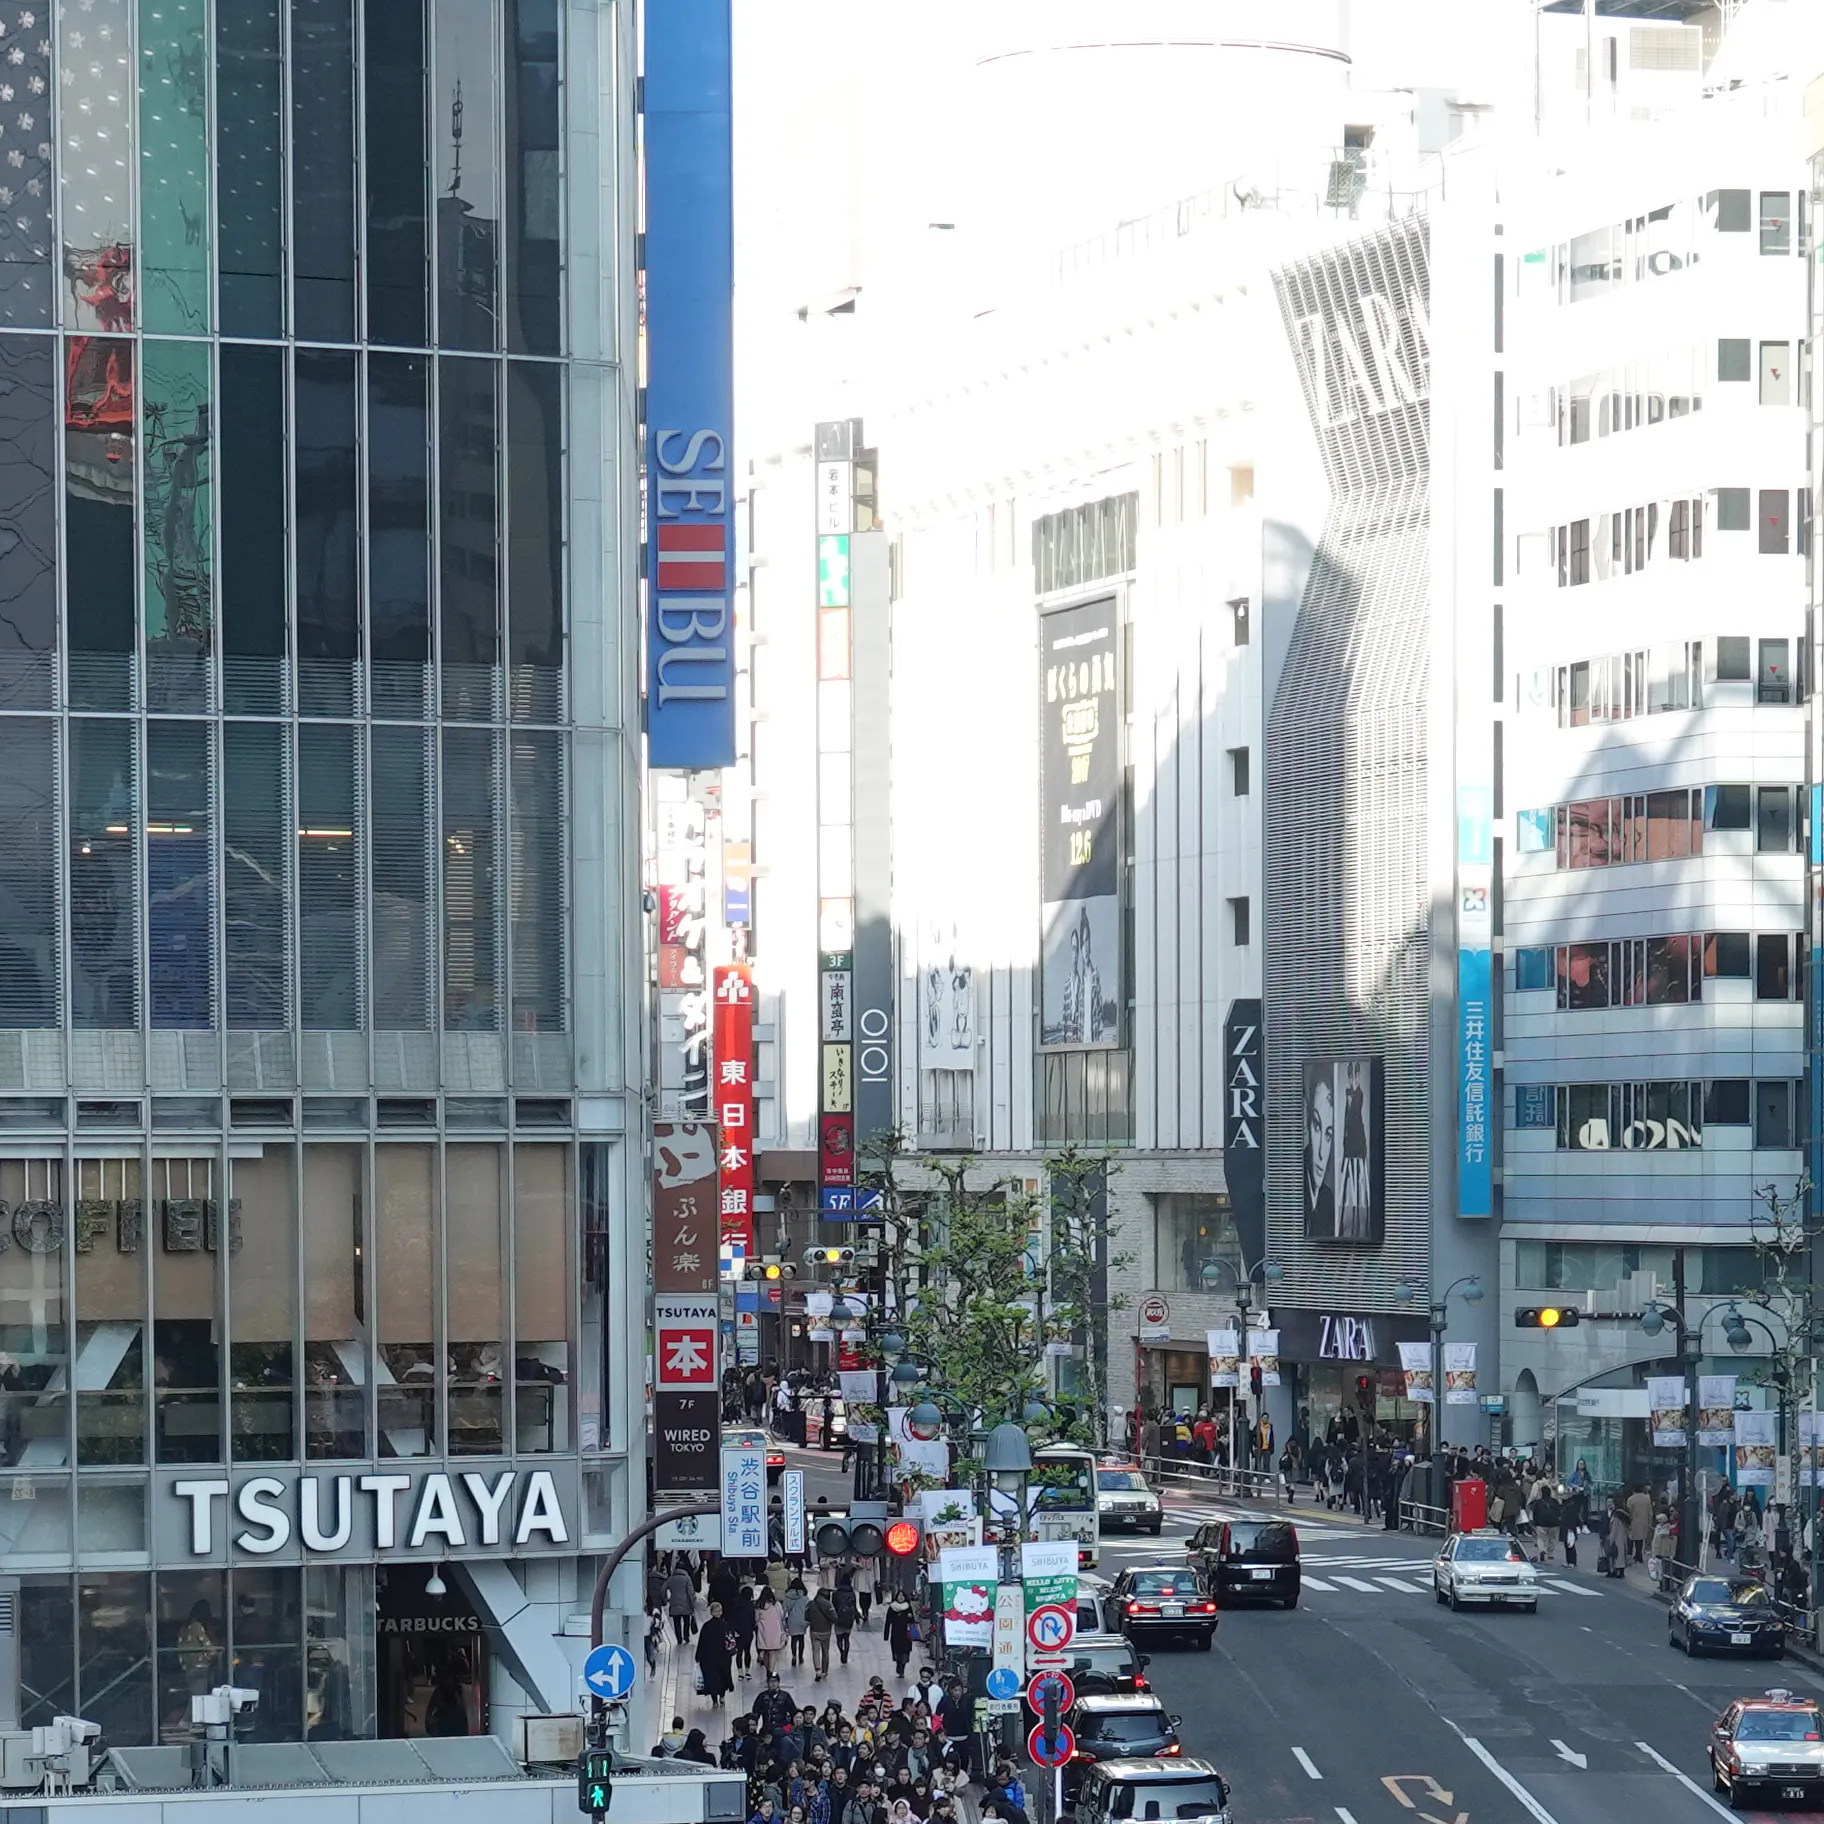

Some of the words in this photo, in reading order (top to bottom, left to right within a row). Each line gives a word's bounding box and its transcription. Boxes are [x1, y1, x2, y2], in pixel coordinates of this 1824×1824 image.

[1295, 288, 1431, 431] ZARA
[656, 428, 728, 707] SEIBU
[829, 956, 845, 968] 3F
[1229, 1024, 1260, 1150] ZARA
[1464, 1001, 1485, 1163] 三井住友信託銀行
[720, 1060, 748, 1248] 東日本銀行
[672, 1197, 701, 1274] ぷん楽
[701, 1278, 714, 1290] 8F
[656, 1307, 717, 1319] TSUTAYA
[666, 1334, 708, 1378] 本
[1319, 1315, 1377, 1362] ZARA
[679, 1399, 695, 1410] 7F
[664, 1429, 711, 1443] WIRED
[670, 1442, 705, 1453] TOKYO
[176, 1469, 570, 1557] TSUTAYA
[726, 1470, 738, 1513] Shibuya
[741, 1456, 761, 1548] 渋谷駅前
[787, 1474, 801, 1550] スクランブル式
[728, 1515, 738, 1538] Sta.
[950, 1562, 989, 1572] SHIBUYA
[1031, 1557, 1069, 1566] SHIBUYA
[998, 1594, 1013, 1669] 公園通
